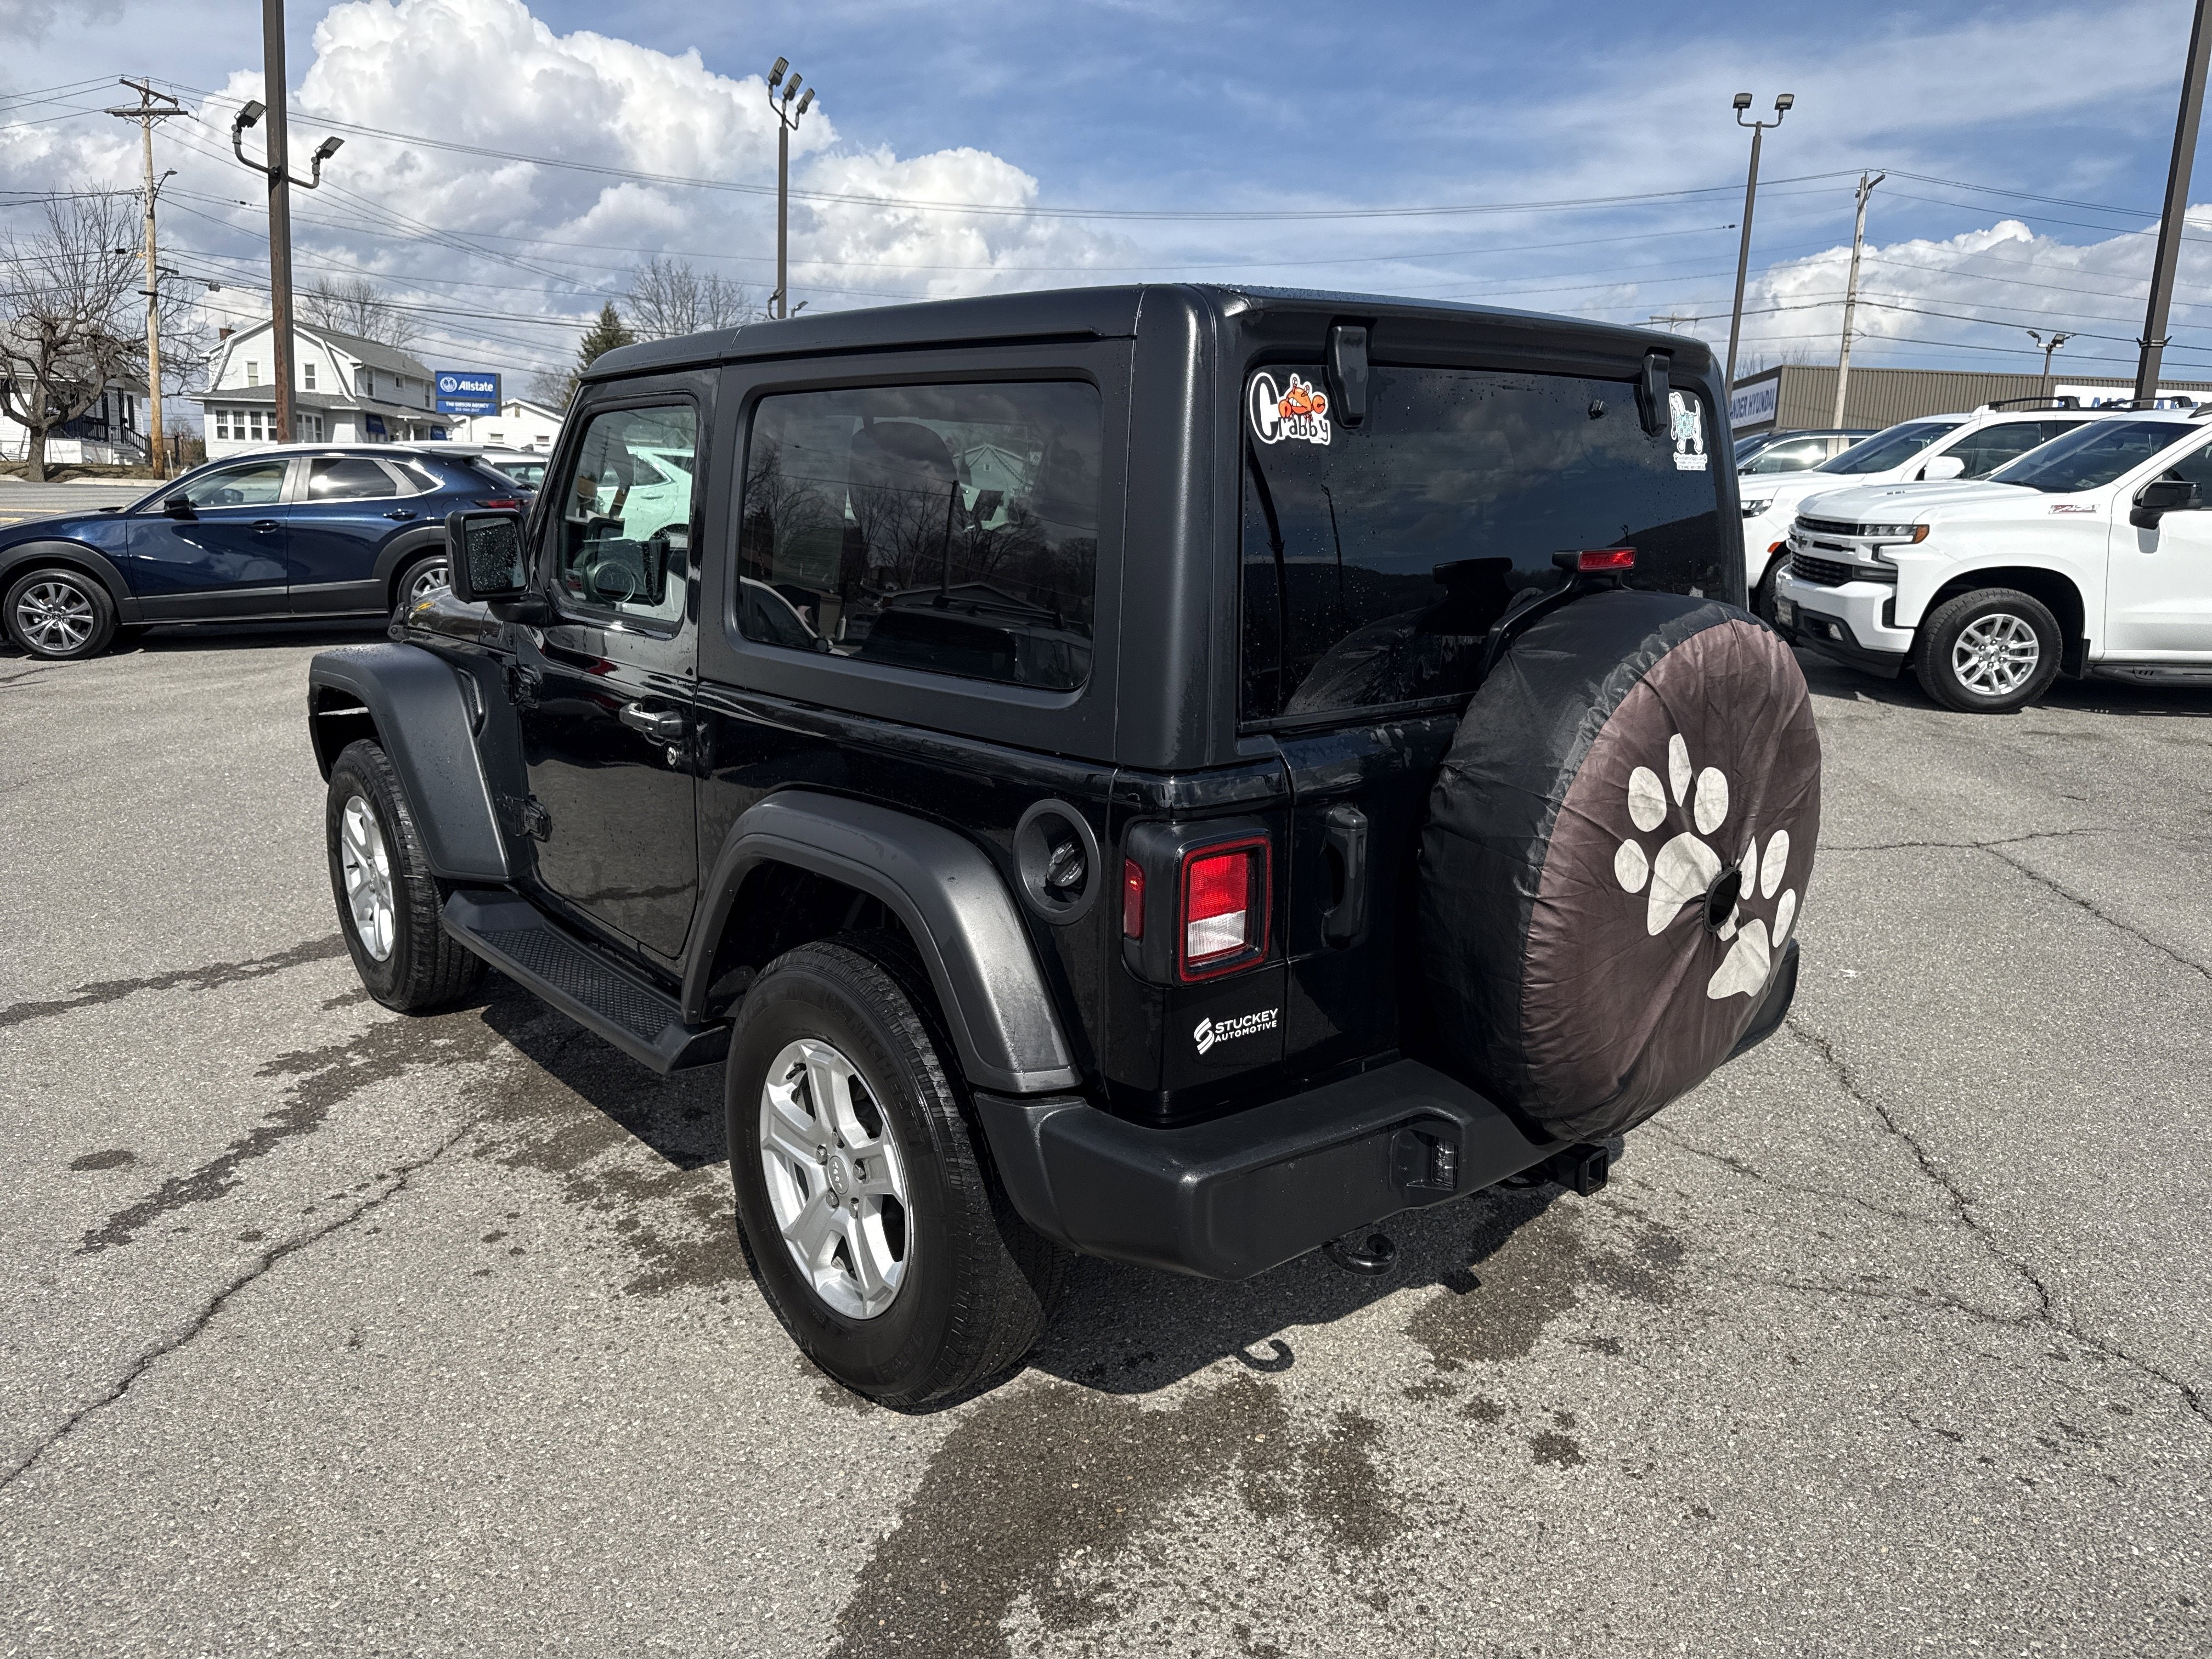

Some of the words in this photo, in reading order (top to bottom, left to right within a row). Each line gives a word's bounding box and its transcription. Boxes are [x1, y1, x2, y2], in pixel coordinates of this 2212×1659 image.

[458, 381, 494, 392] Allstate
[1252, 375, 1328, 442] Crabby
[1215, 1008, 1278, 1034] STUCKEY
[1215, 1020, 1277, 1043] AUTOMOTIVE
